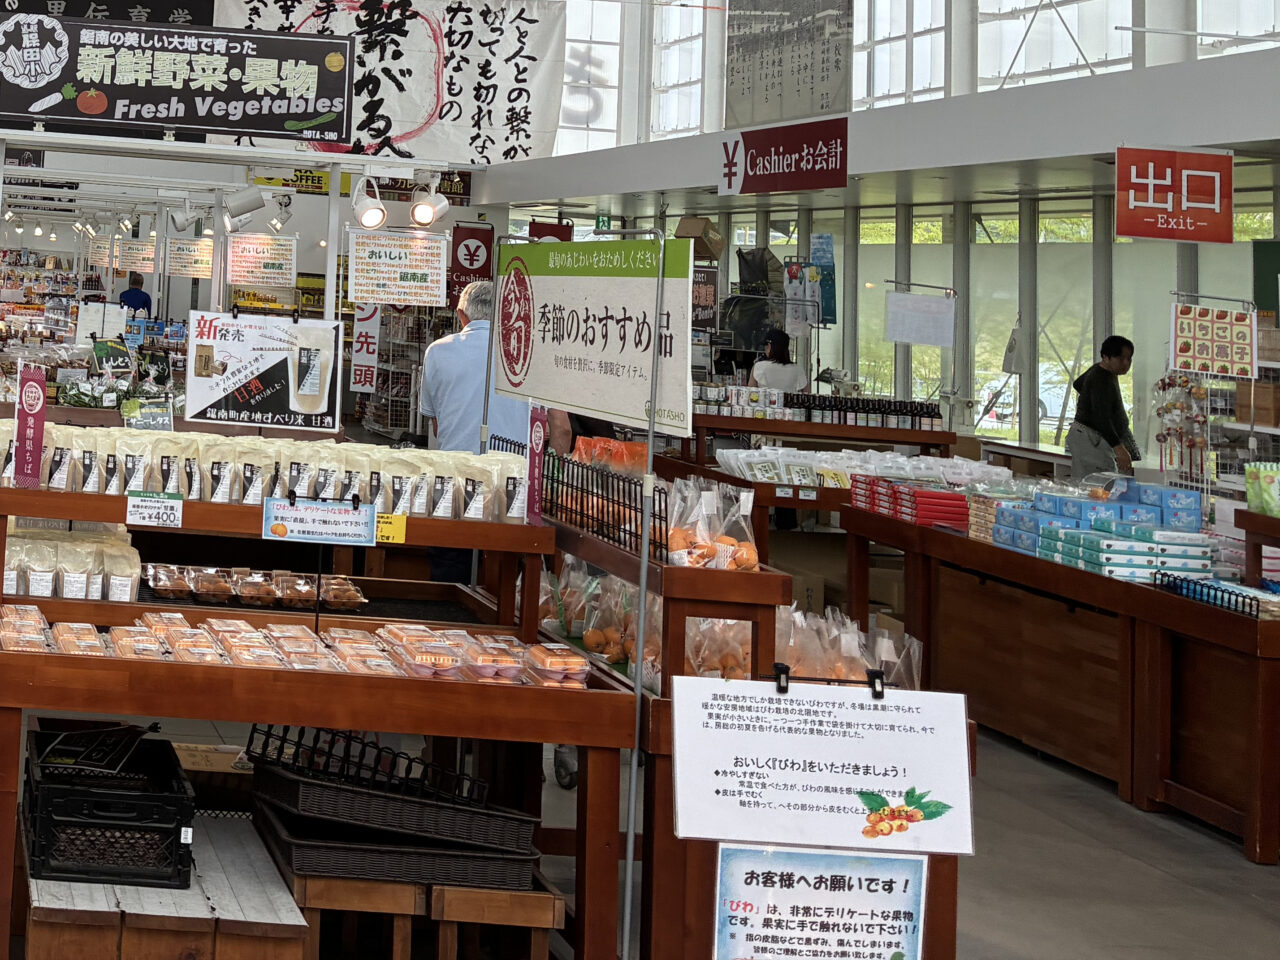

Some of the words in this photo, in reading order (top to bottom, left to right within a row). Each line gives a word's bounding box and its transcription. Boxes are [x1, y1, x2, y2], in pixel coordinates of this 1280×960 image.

[80, 28, 257, 55] 鋸南の美しい大地で育った
[77, 46, 318, 98] 新鮮野菜・果物
[114, 99, 186, 120] Fresh
[194, 95, 344, 121] Vegetables
[746, 147, 799, 177] Cashier
[801, 138, 843, 171] お会計
[1128, 161, 1221, 213] 出口
[1158, 214, 1195, 231] Exit
[368, 250, 408, 261] おいしい
[538, 303, 673, 358] 季節のおすすめ品
[1180, 320, 1247, 342] いちごの
[1197, 342, 1249, 361] お菓子
[233, 377, 264, 404] 甘酒
[312, 415, 333, 428] 甘酒
[147, 511, 176, 524] ¥400
[721, 770, 769, 780] 冷やしすぎない
[733, 755, 908, 778] おいしく『びわ』をいただきましょう！
[721, 789, 763, 799] 皮は手でむく
[744, 870, 909, 894] お客様へお願いです！
[727, 915, 917, 935] です。果実に手で触れないで下さい！
